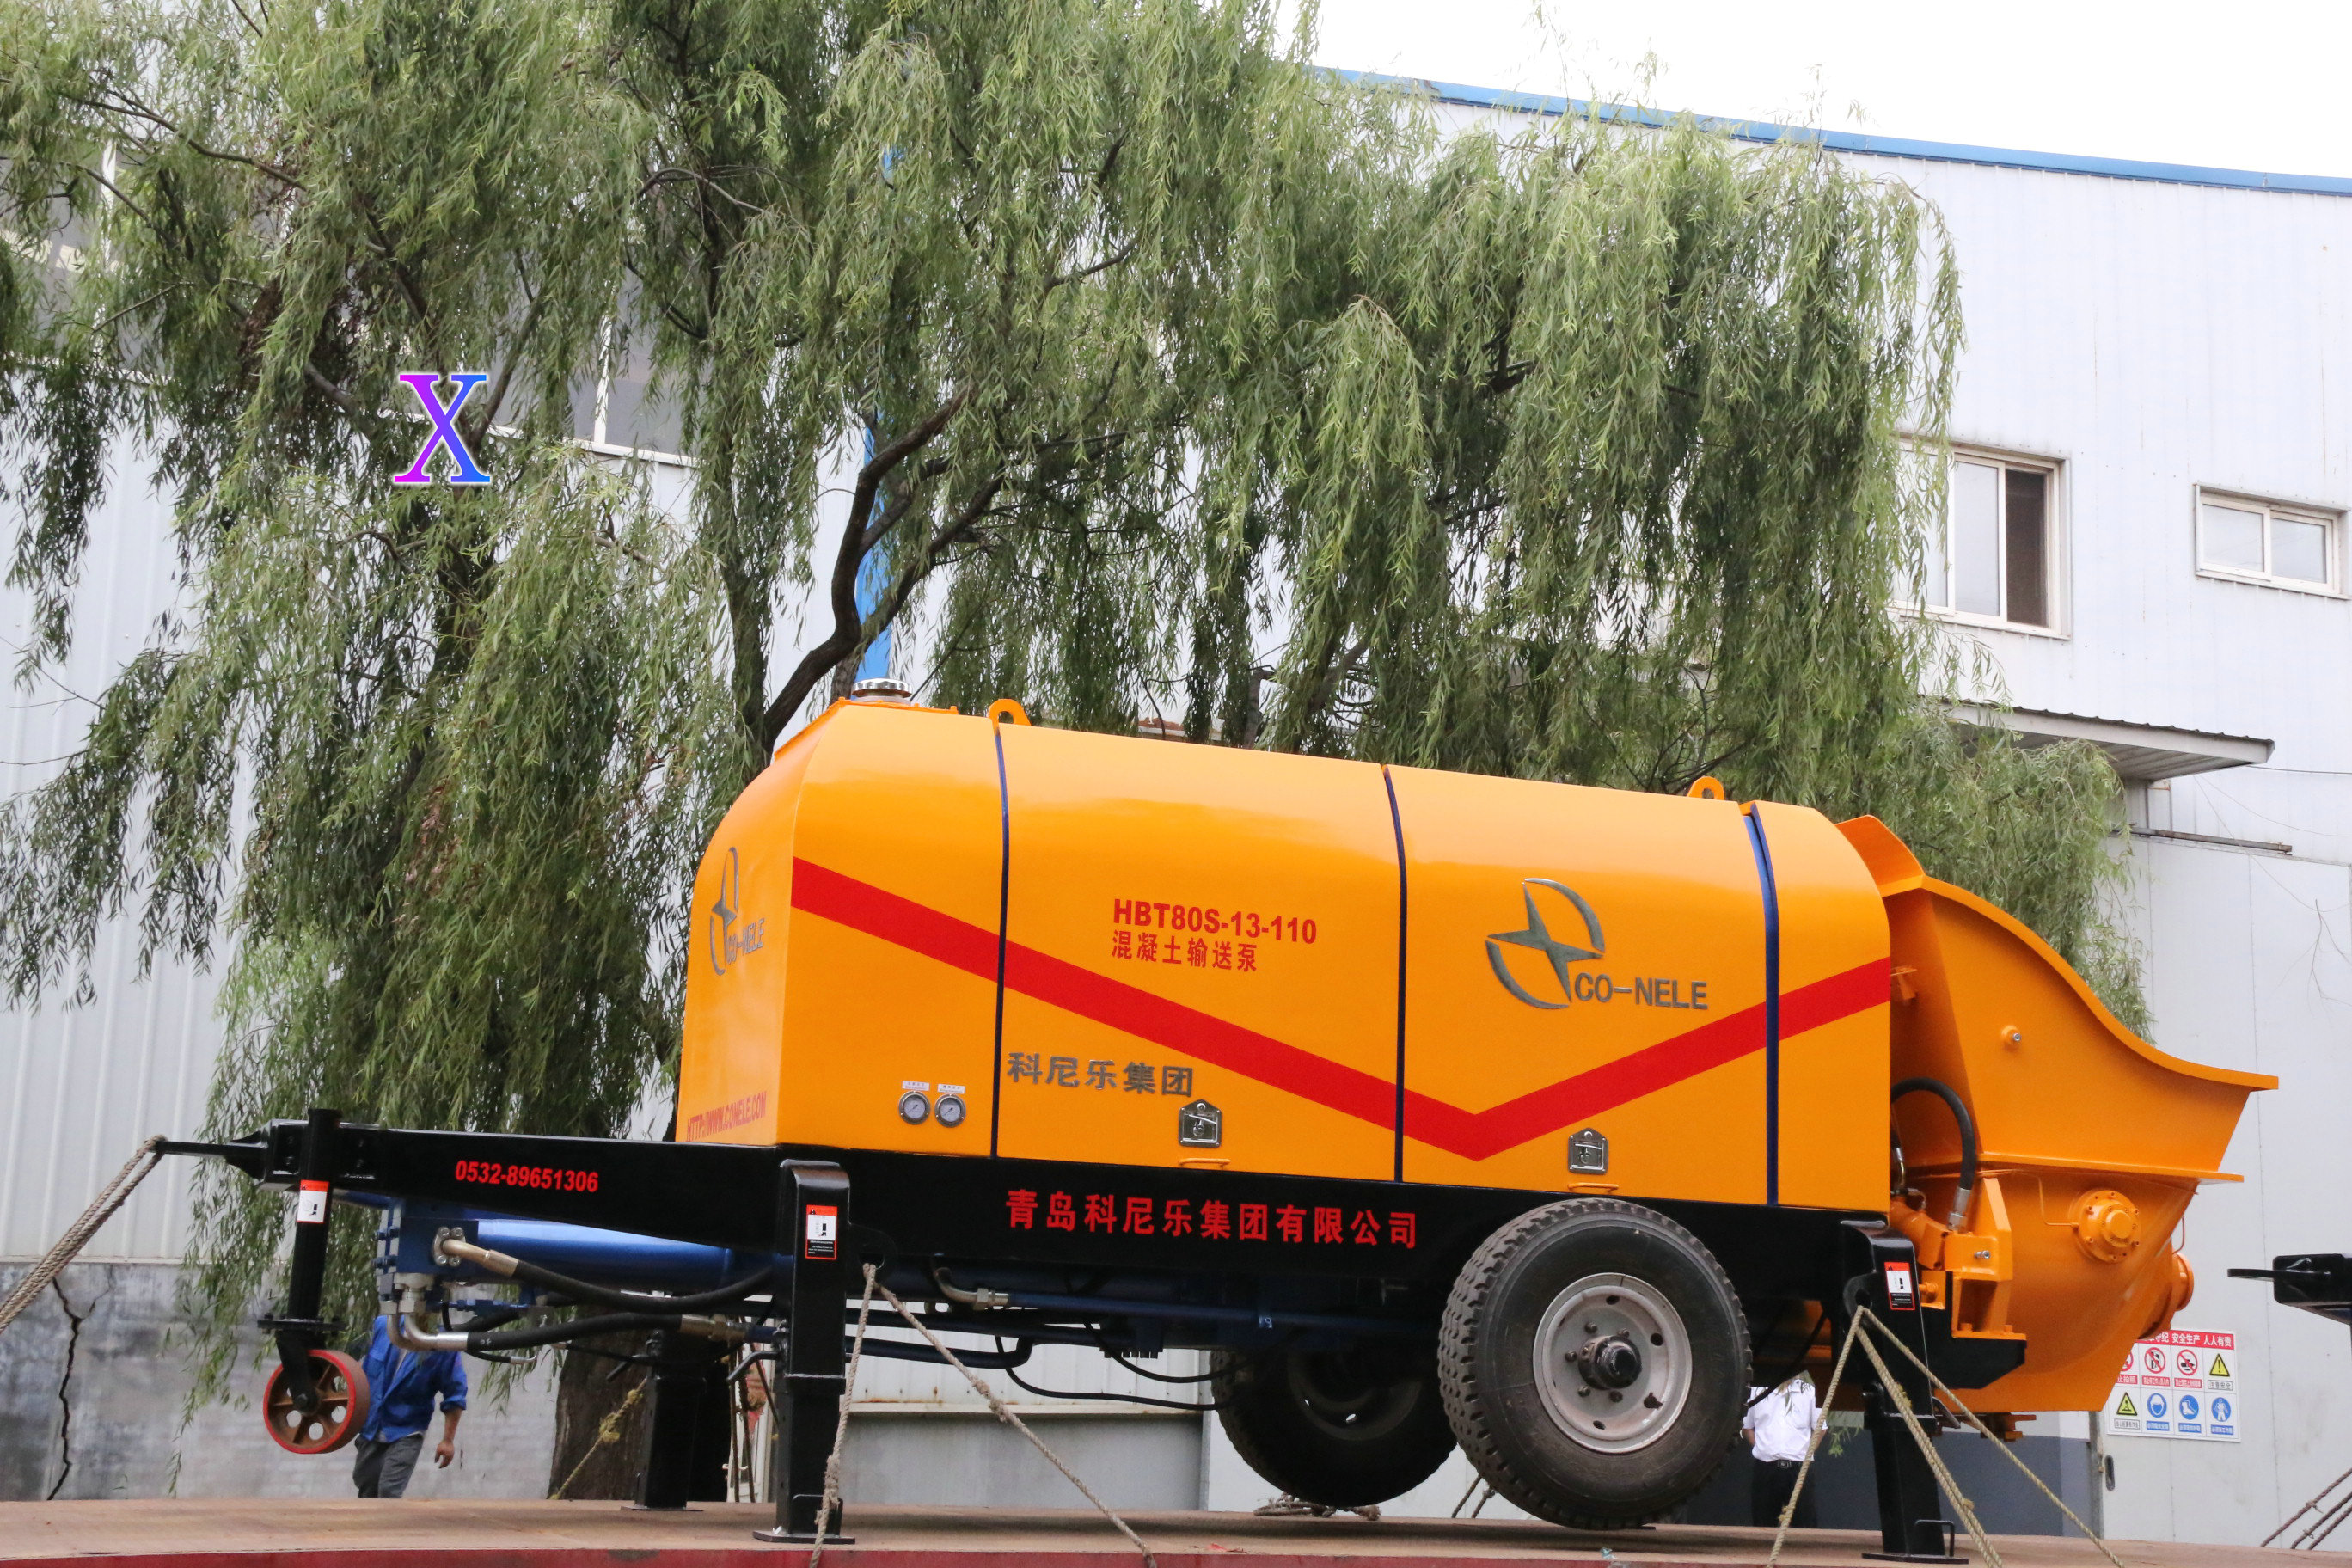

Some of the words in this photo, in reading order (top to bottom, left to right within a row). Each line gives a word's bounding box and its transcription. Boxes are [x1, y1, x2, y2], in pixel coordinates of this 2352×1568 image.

[1113, 898, 1316, 945] HBT80S-13-110
[1112, 929, 1258, 973] 混凝土输送泵
[1574, 971, 1708, 1010] CO-NELE
[1006, 1051, 1193, 1097] 科尼乐集团
[455, 1160, 599, 1193] 0532-89651306
[1006, 1189, 1417, 1250] 青岛科尼乐集团有限公司
[2171, 1332, 2201, 1344] 安全生产
